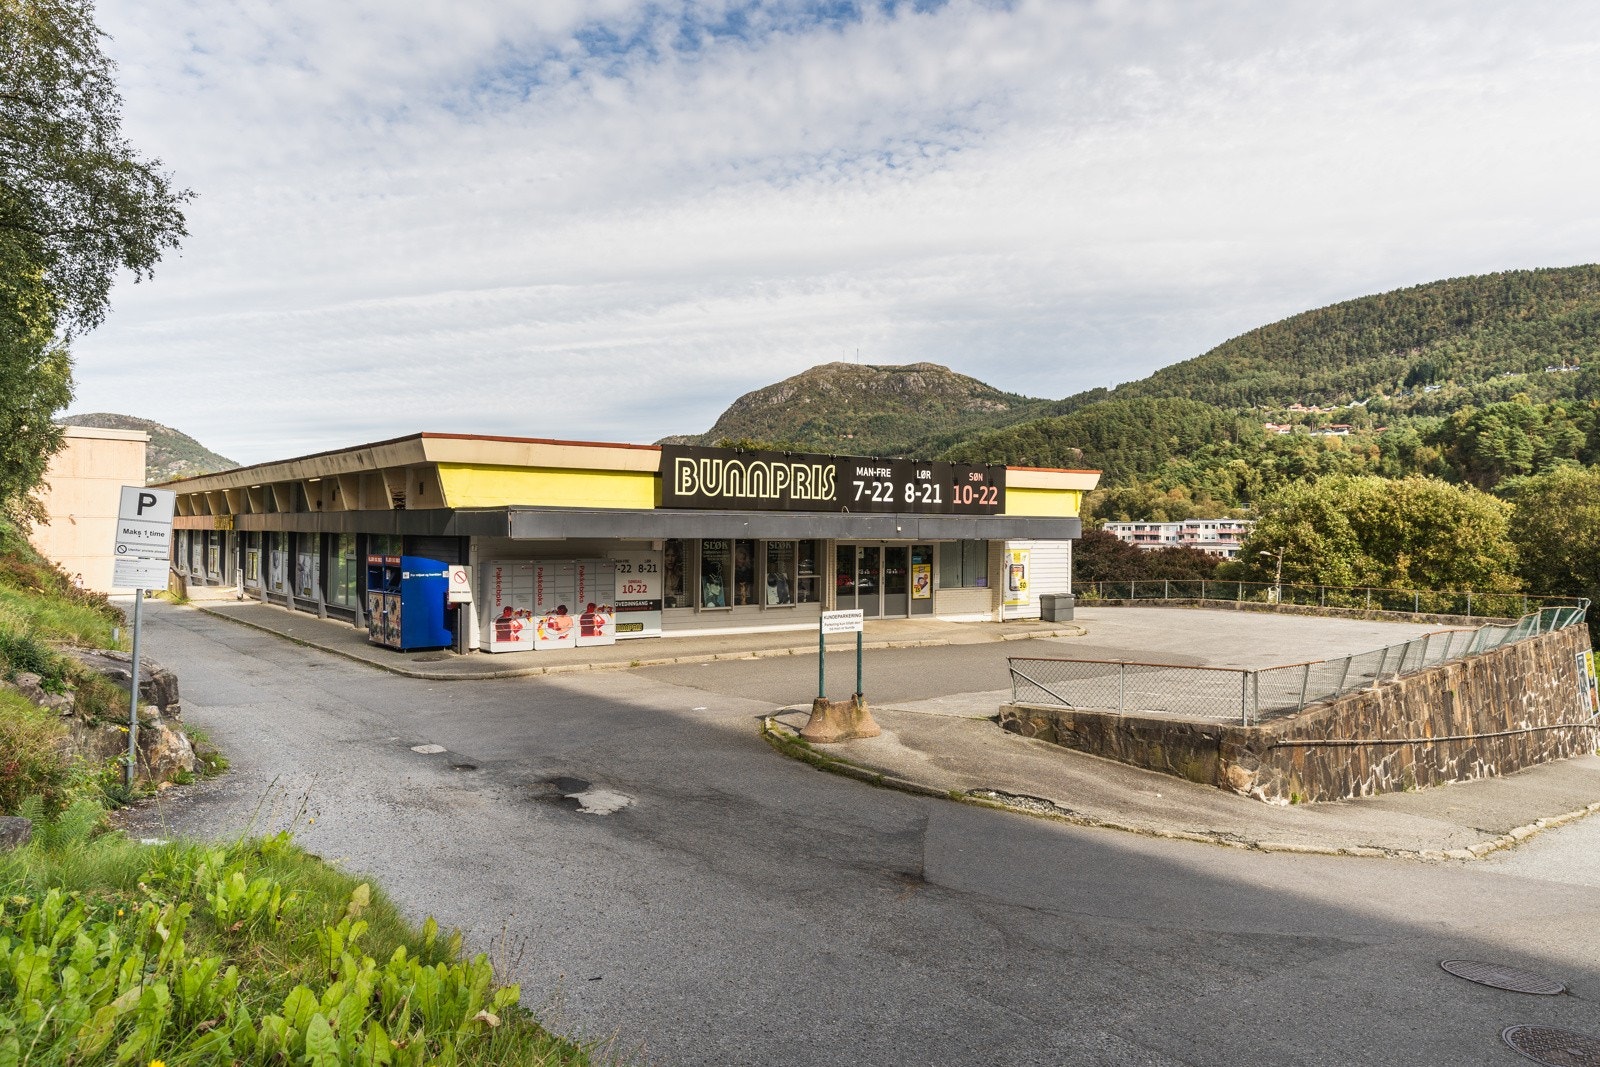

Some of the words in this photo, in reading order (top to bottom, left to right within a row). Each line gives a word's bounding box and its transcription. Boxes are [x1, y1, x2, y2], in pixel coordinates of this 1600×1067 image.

[856, 466, 891, 478] MAN-FRE
[917, 470, 931, 479] LØR
[968, 472, 983, 481] SØN
[675, 457, 837, 501] BUNNPRIS
[853, 481, 894, 502] 7-22
[904, 483, 942, 503] 8-21
[953, 485, 998, 505] 10-22
[137, 492, 157, 516] P
[122, 528, 141, 536] Maks
[638, 564, 658, 573] 8-21
[622, 584, 648, 594] 10-22
